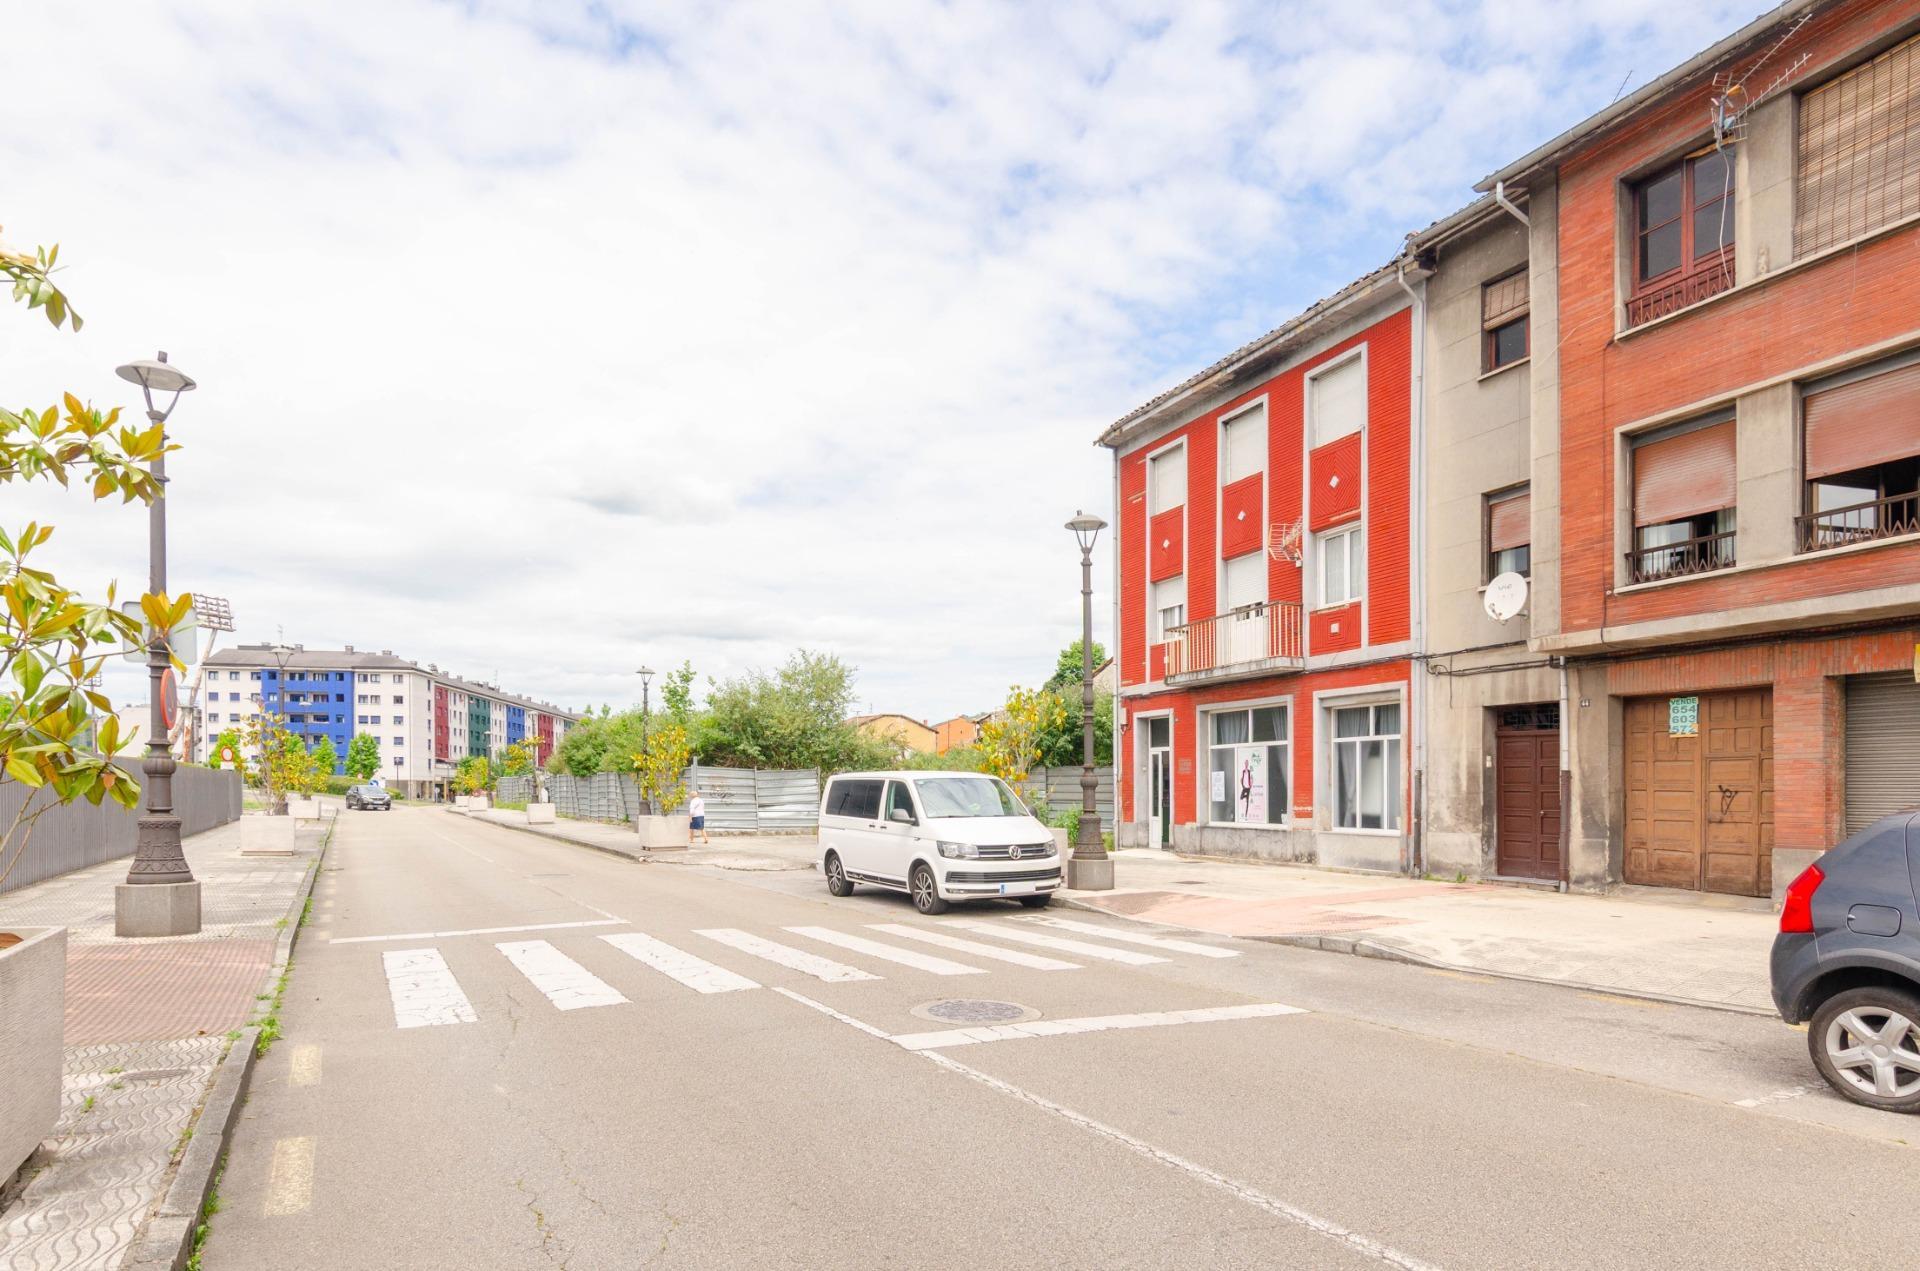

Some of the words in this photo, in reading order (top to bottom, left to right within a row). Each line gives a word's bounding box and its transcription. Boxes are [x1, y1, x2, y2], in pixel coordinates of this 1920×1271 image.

[1671, 697, 1697, 705] VENDE
[1672, 705, 1697, 714] 654
[1672, 715, 1696, 724] 603
